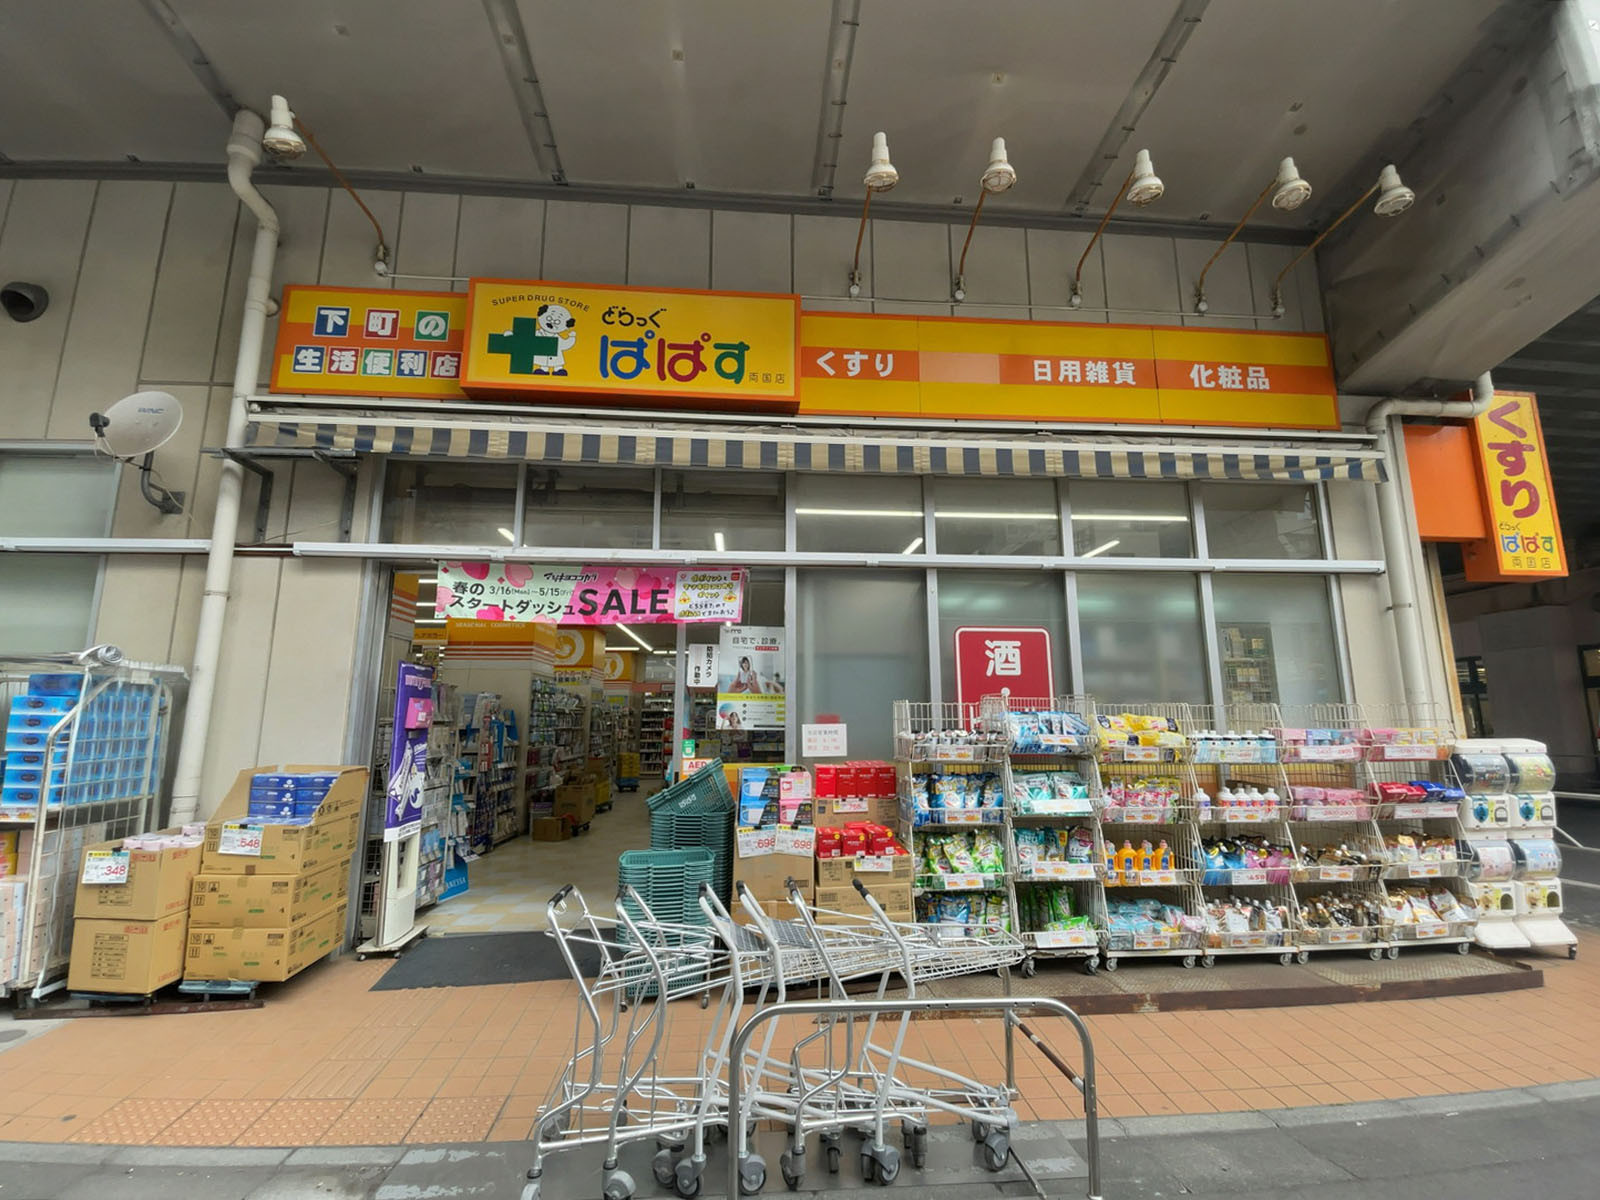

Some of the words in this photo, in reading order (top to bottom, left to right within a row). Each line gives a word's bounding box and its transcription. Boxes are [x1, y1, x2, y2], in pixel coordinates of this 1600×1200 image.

[492, 294, 525, 306] SUPER
[527, 294, 555, 303] DRUG
[558, 296, 590, 312] STORE
[319, 309, 446, 337] 下町の
[601, 306, 667, 328] どらっぐ
[295, 348, 459, 377] 生活便利店
[599, 329, 750, 385] ぱぱす
[816, 351, 894, 377] くすり
[749, 373, 785, 385] 両国店
[1033, 359, 1137, 385] 日用雑貨
[1189, 363, 1271, 390] 化粧品
[1487, 400, 1541, 518] くすり
[1501, 532, 1554, 554] ぱぱす
[452, 581, 485, 595] 春の
[449, 594, 575, 616] スタートダッシュ
[578, 588, 669, 616] SALE
[984, 639, 1022, 677] 酒
[688, 761, 707, 769] AED
[240, 838, 260, 848] 548
[757, 837, 776, 849] 698
[793, 839, 812, 850] 698
[104, 865, 126, 876] 348
